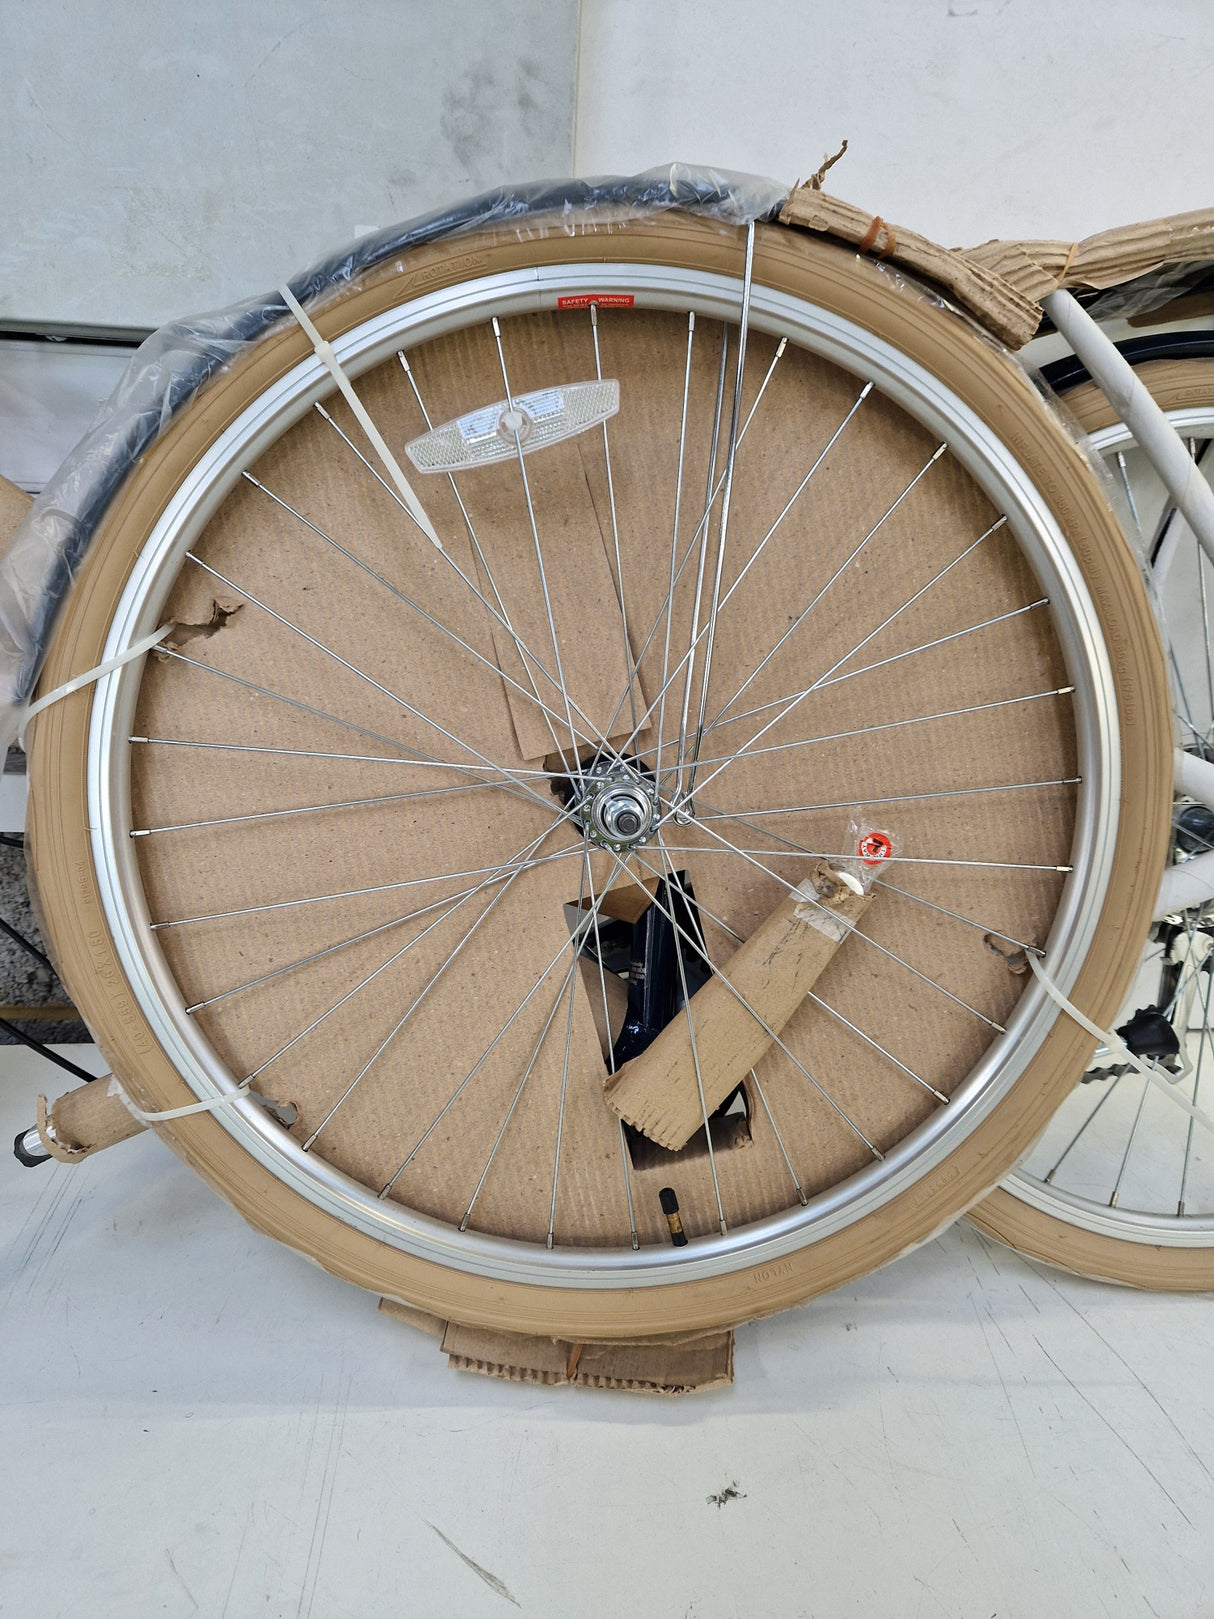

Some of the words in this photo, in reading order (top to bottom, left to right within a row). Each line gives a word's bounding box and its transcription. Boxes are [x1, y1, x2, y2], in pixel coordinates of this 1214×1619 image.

[421, 254, 482, 280] ROTATION
[561, 297, 588, 305] SAFETY
[1009, 431, 1046, 475] INFLATE
[1043, 477, 1058, 494] TO
[752, 1261, 793, 1283] NYLON
